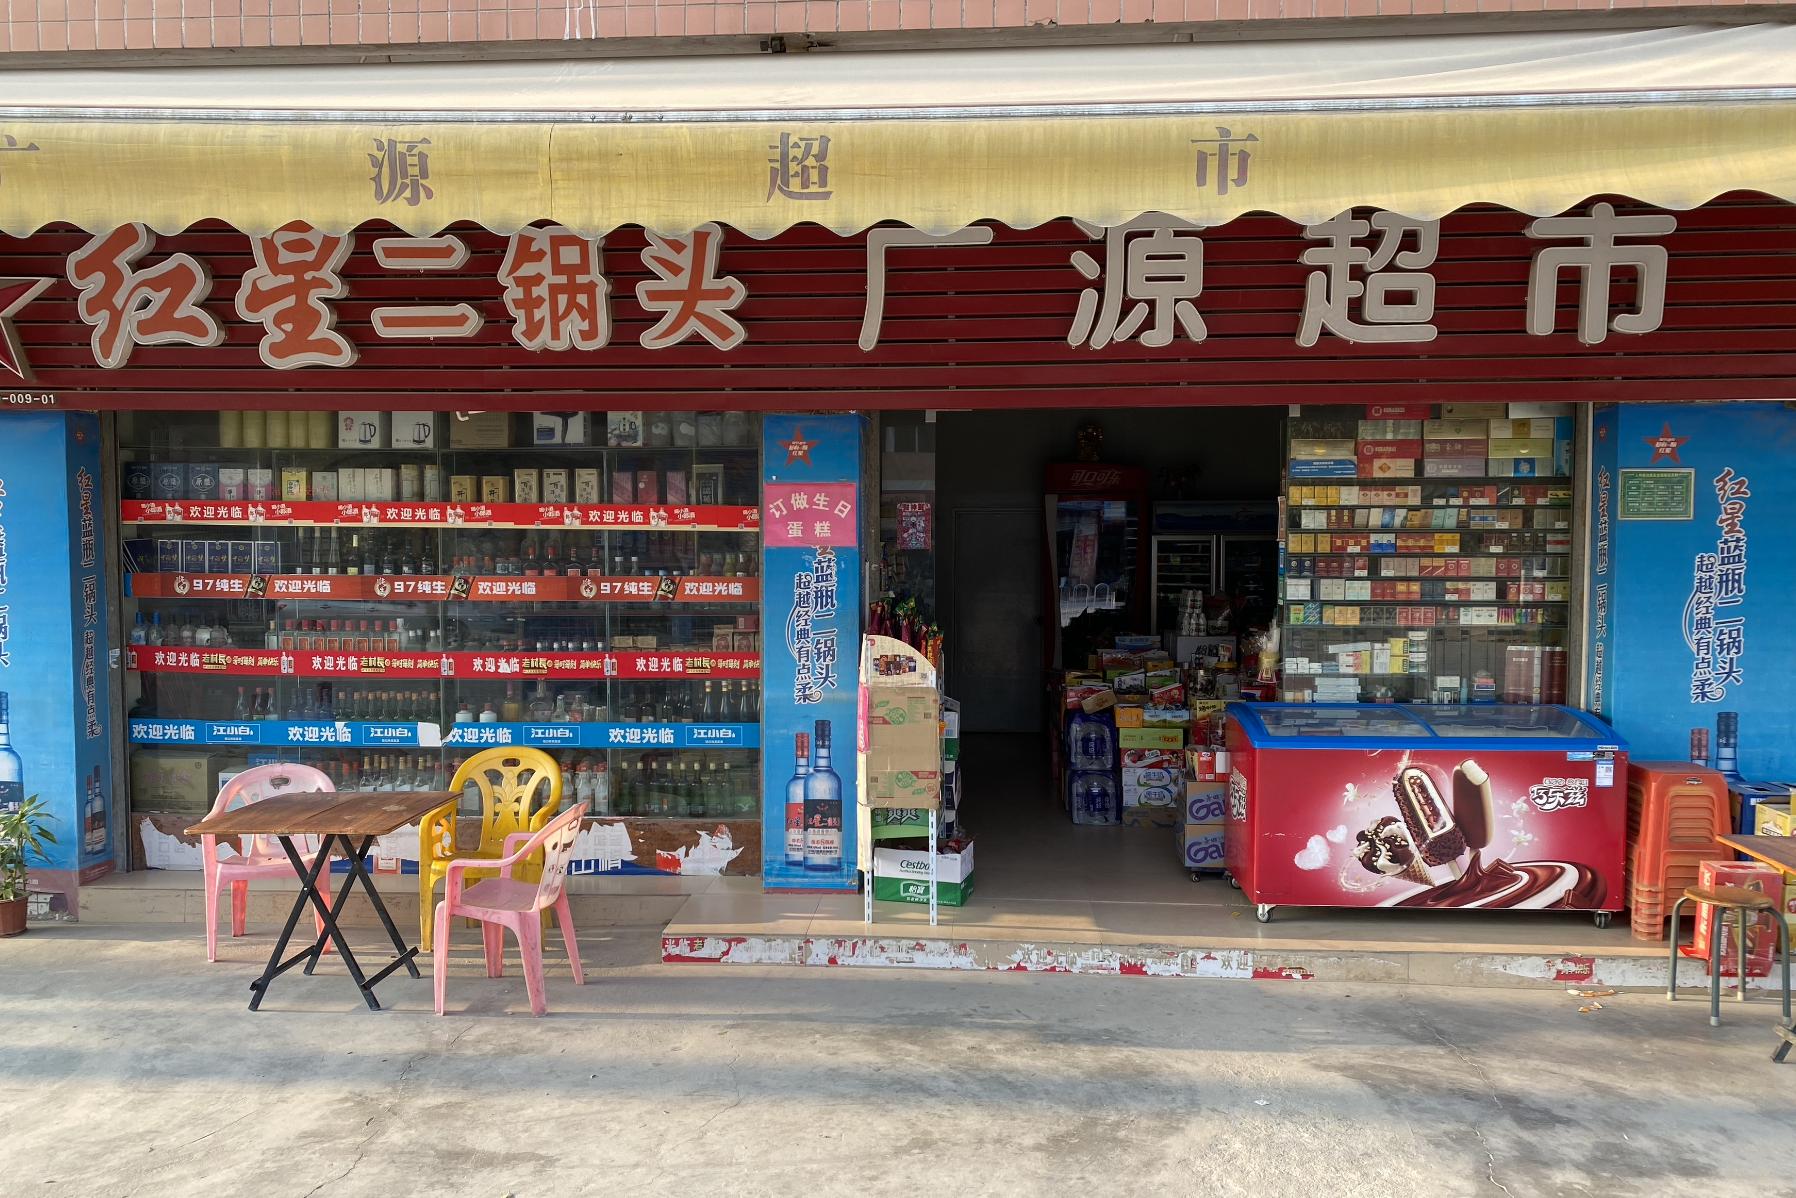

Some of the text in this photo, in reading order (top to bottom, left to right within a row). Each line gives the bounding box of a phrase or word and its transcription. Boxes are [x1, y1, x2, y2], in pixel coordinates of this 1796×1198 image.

[369, 137, 432, 207] 源
[766, 132, 833, 202] 超
[1190, 127, 1259, 195] 市
[769, 491, 852, 519] 订做生日
[189, 506, 243, 518] 欢迎光临
[386, 508, 441, 520] 欢迎光临
[588, 510, 644, 523] 欢迎光临
[787, 521, 831, 538] 蛋糕
[1713, 467, 1751, 686] 红星蓝瓶二锅头
[193, 579, 243, 592] 97纯生
[273, 580, 331, 593] 欢迎光临
[394, 581, 446, 593] 97纯生
[477, 582, 537, 595] 欢迎光临
[600, 582, 653, 595] 97纯生
[685, 582, 743, 595] 欢迎光临
[154, 651, 200, 667] 欢迎光临
[311, 655, 358, 671] 欢迎光临
[635, 657, 683, 672] 欢迎光临
[133, 723, 250, 740] 欢迎光临 江小白
[369, 727, 408, 737] 江小白
[531, 728, 570, 738] 江小白
[608, 728, 733, 744] 欢迎光临 江小白
[1530, 785, 1588, 812] 巧乐兹
